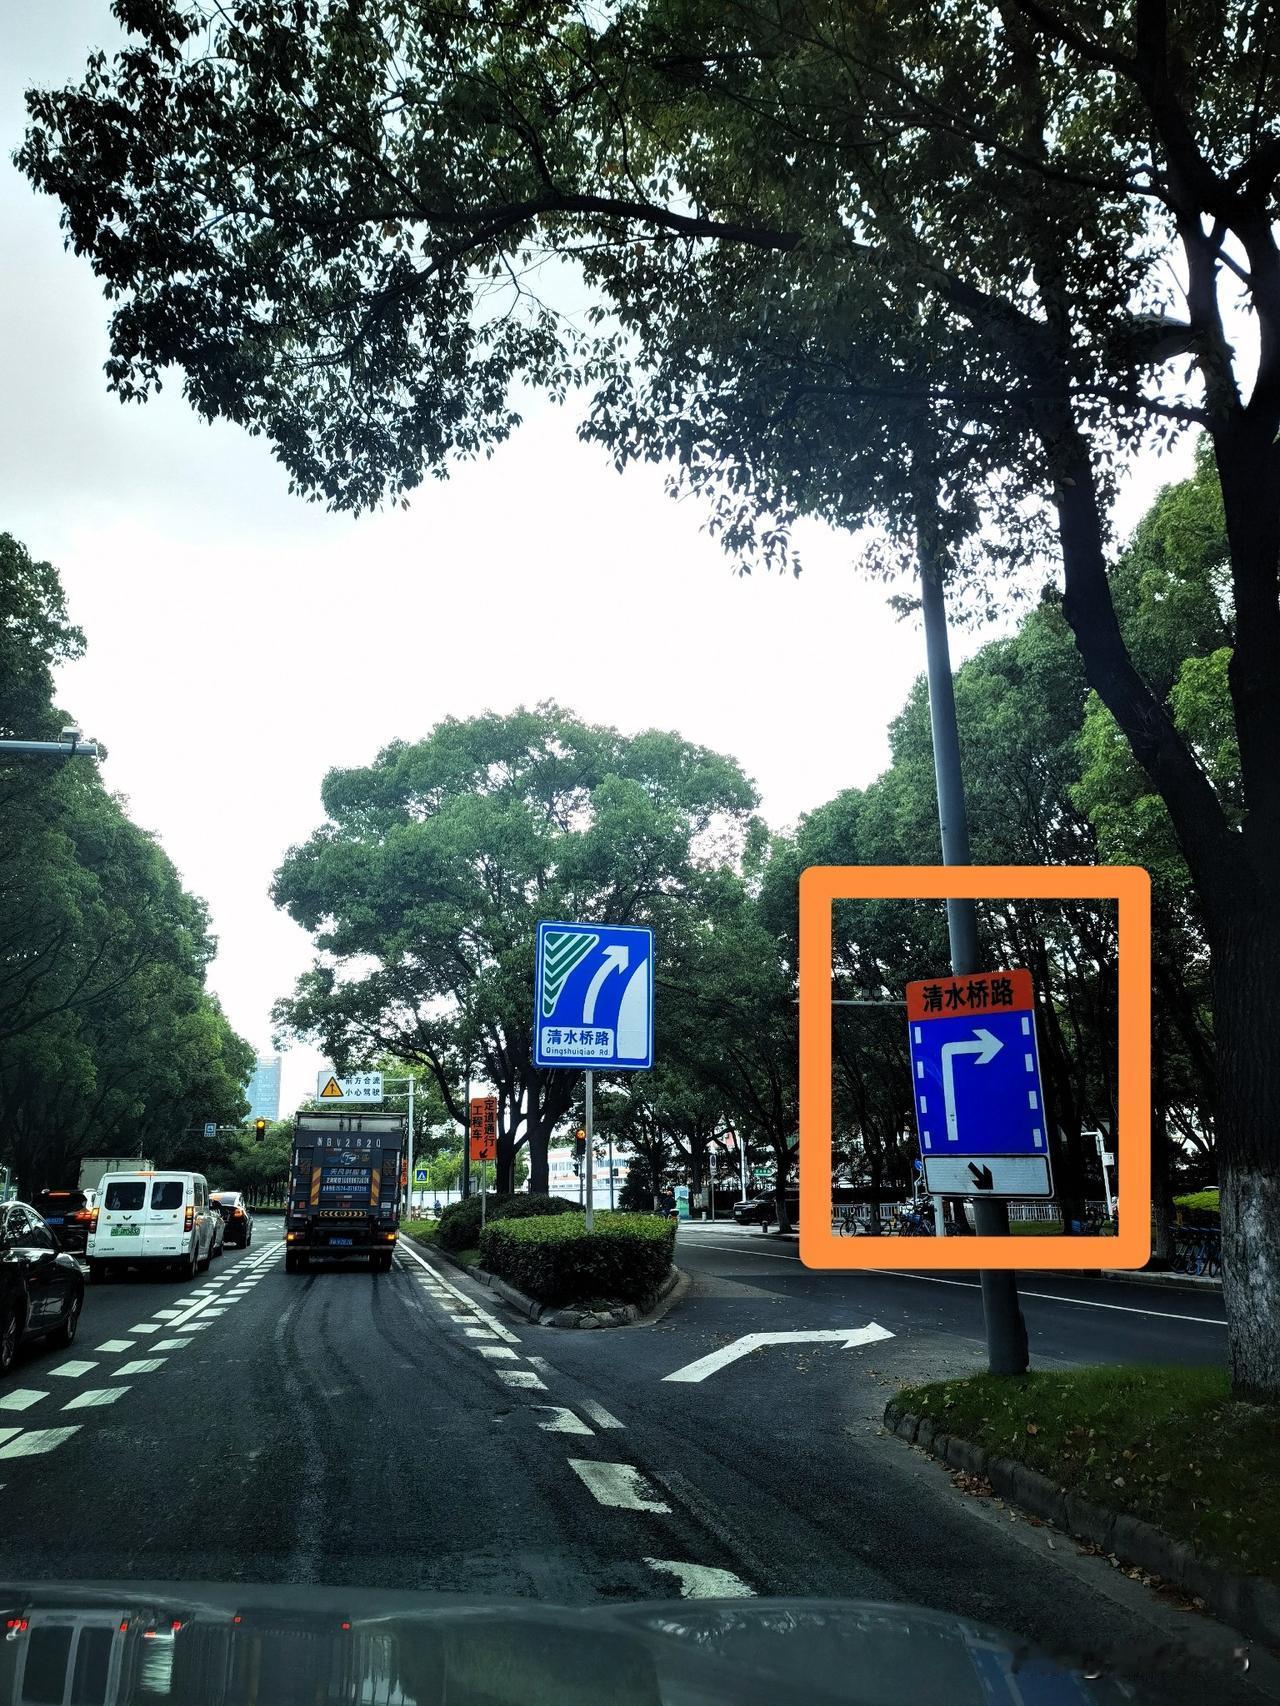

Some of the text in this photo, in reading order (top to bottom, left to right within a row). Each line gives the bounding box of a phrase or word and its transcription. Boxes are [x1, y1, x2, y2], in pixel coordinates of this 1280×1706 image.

[922, 977, 1014, 1012] 清水桥路
[547, 1029, 610, 1046] 清水桥路
[546, 1046, 595, 1056] Qingshuiqiao
[345, 1076, 380, 1085] 前方合流
[345, 1088, 380, 1097] 小心驾驶
[472, 1105, 483, 1141] 工程车
